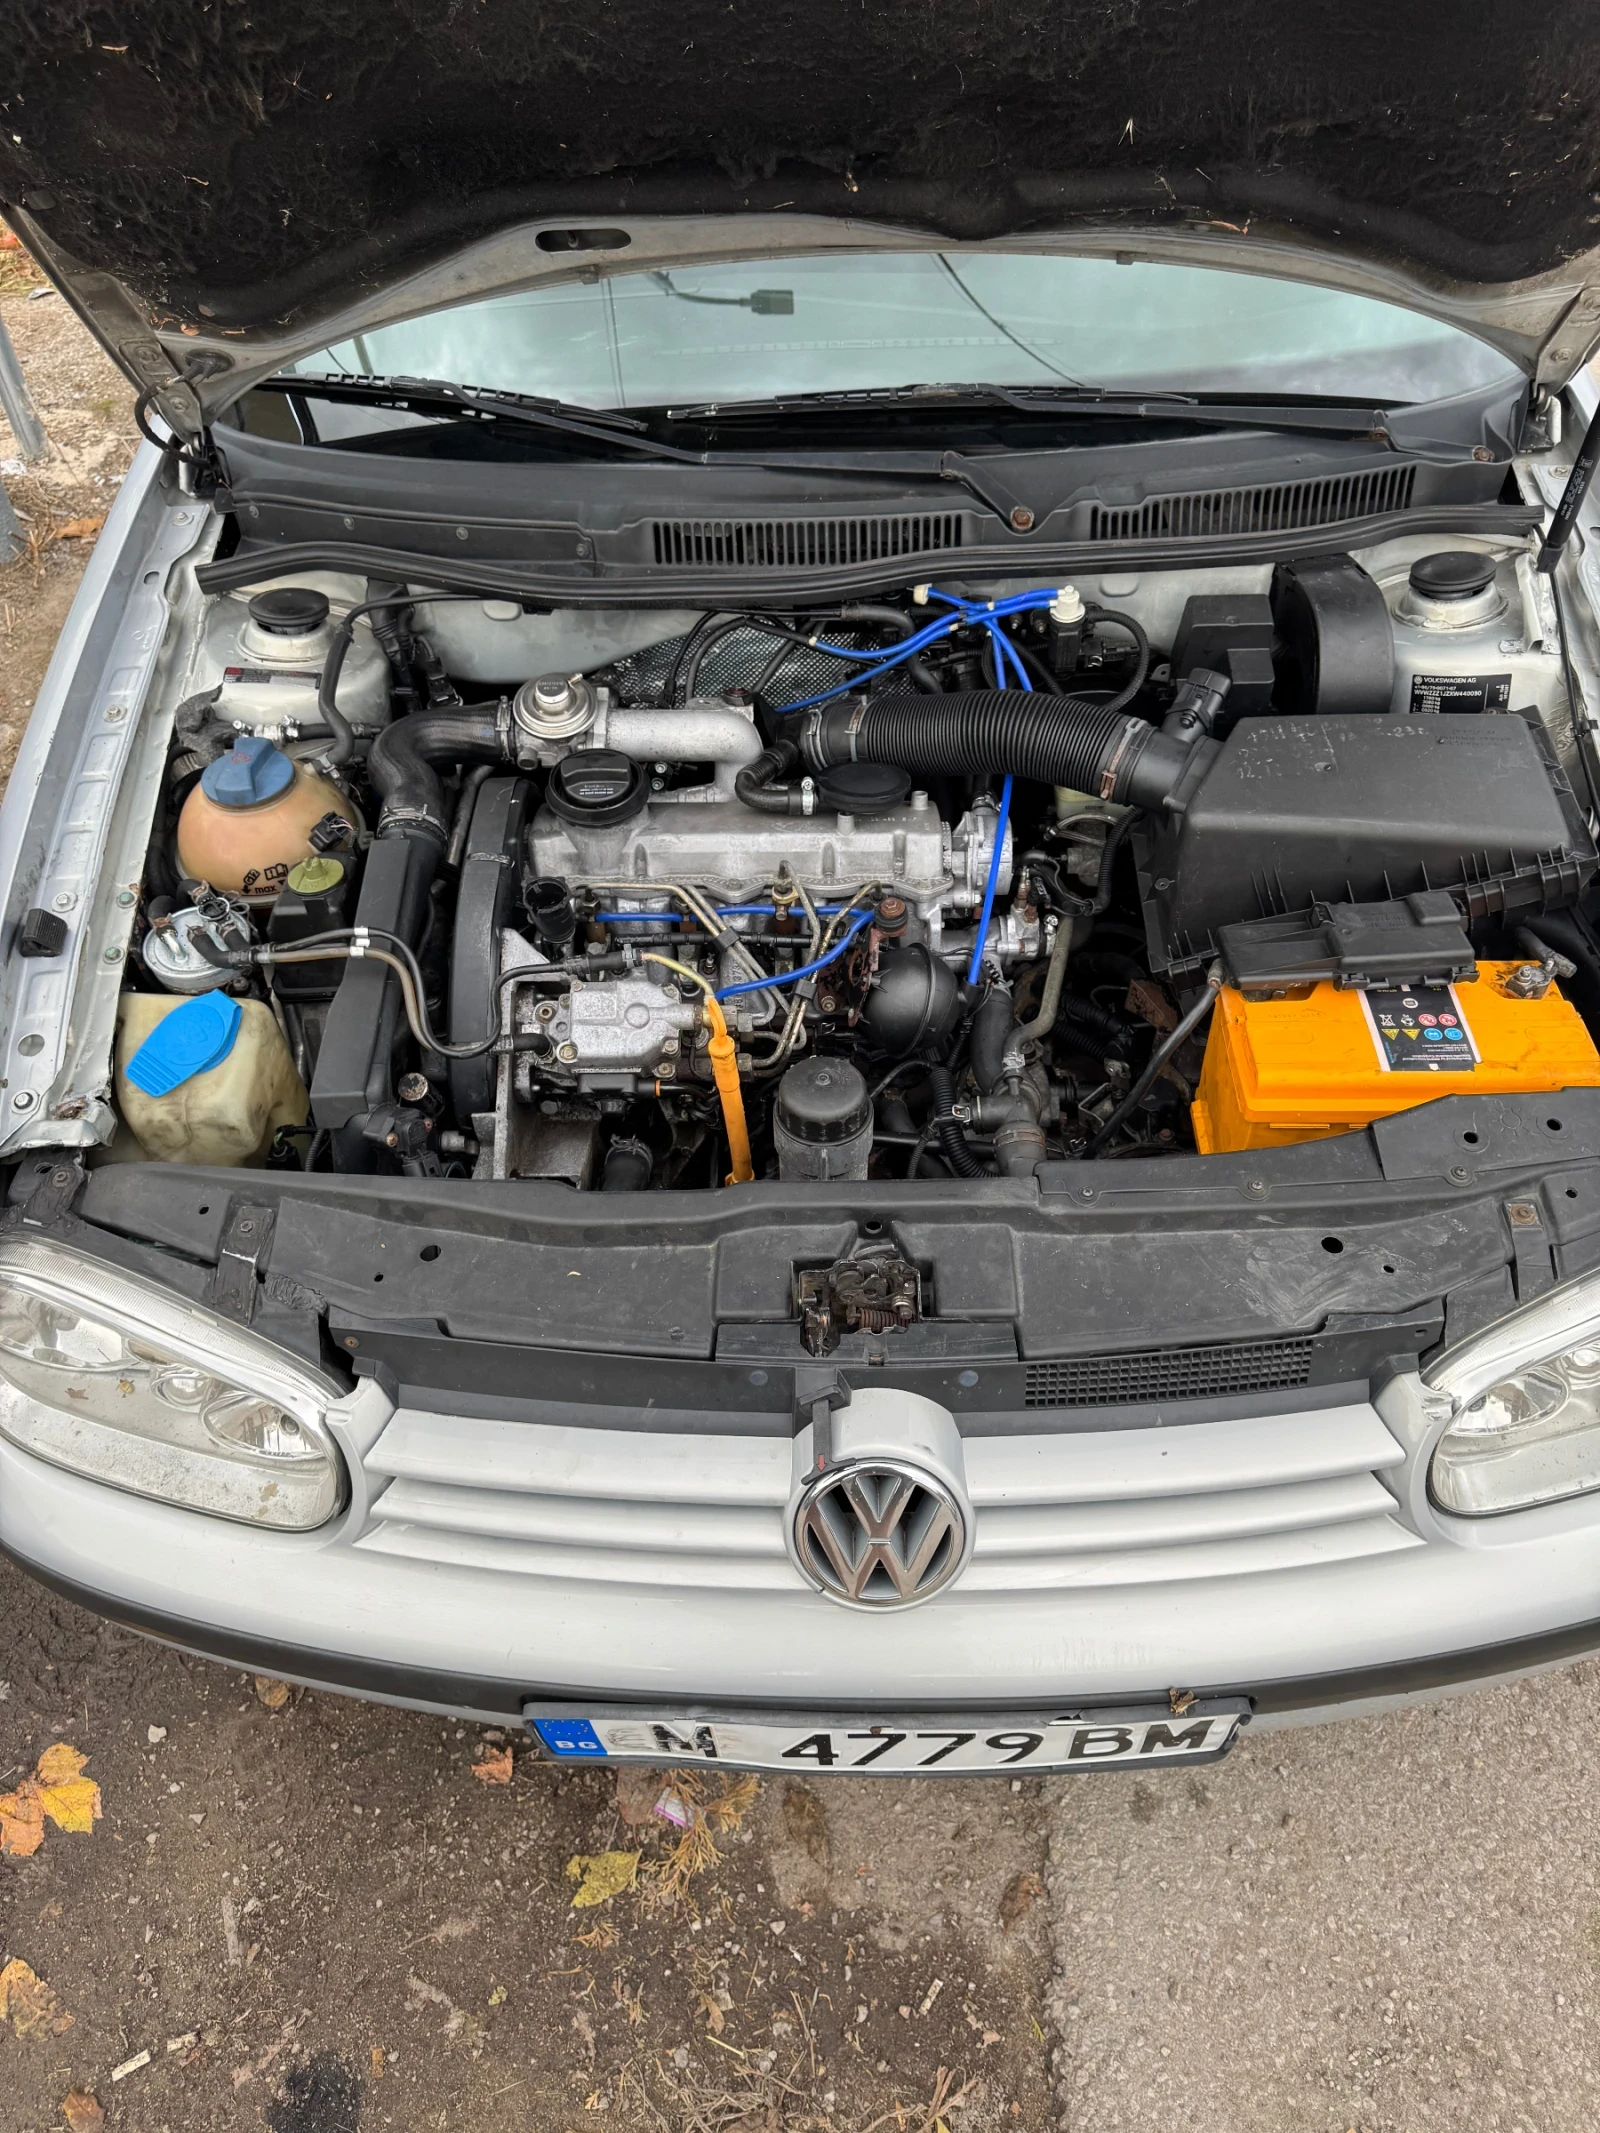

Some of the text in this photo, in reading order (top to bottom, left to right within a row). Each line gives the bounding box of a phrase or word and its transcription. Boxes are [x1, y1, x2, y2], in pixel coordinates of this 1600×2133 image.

[255, 885, 277, 894] max
[554, 1740, 599, 1750] BG
[650, 1718, 1217, 1766] M 4779 BM
